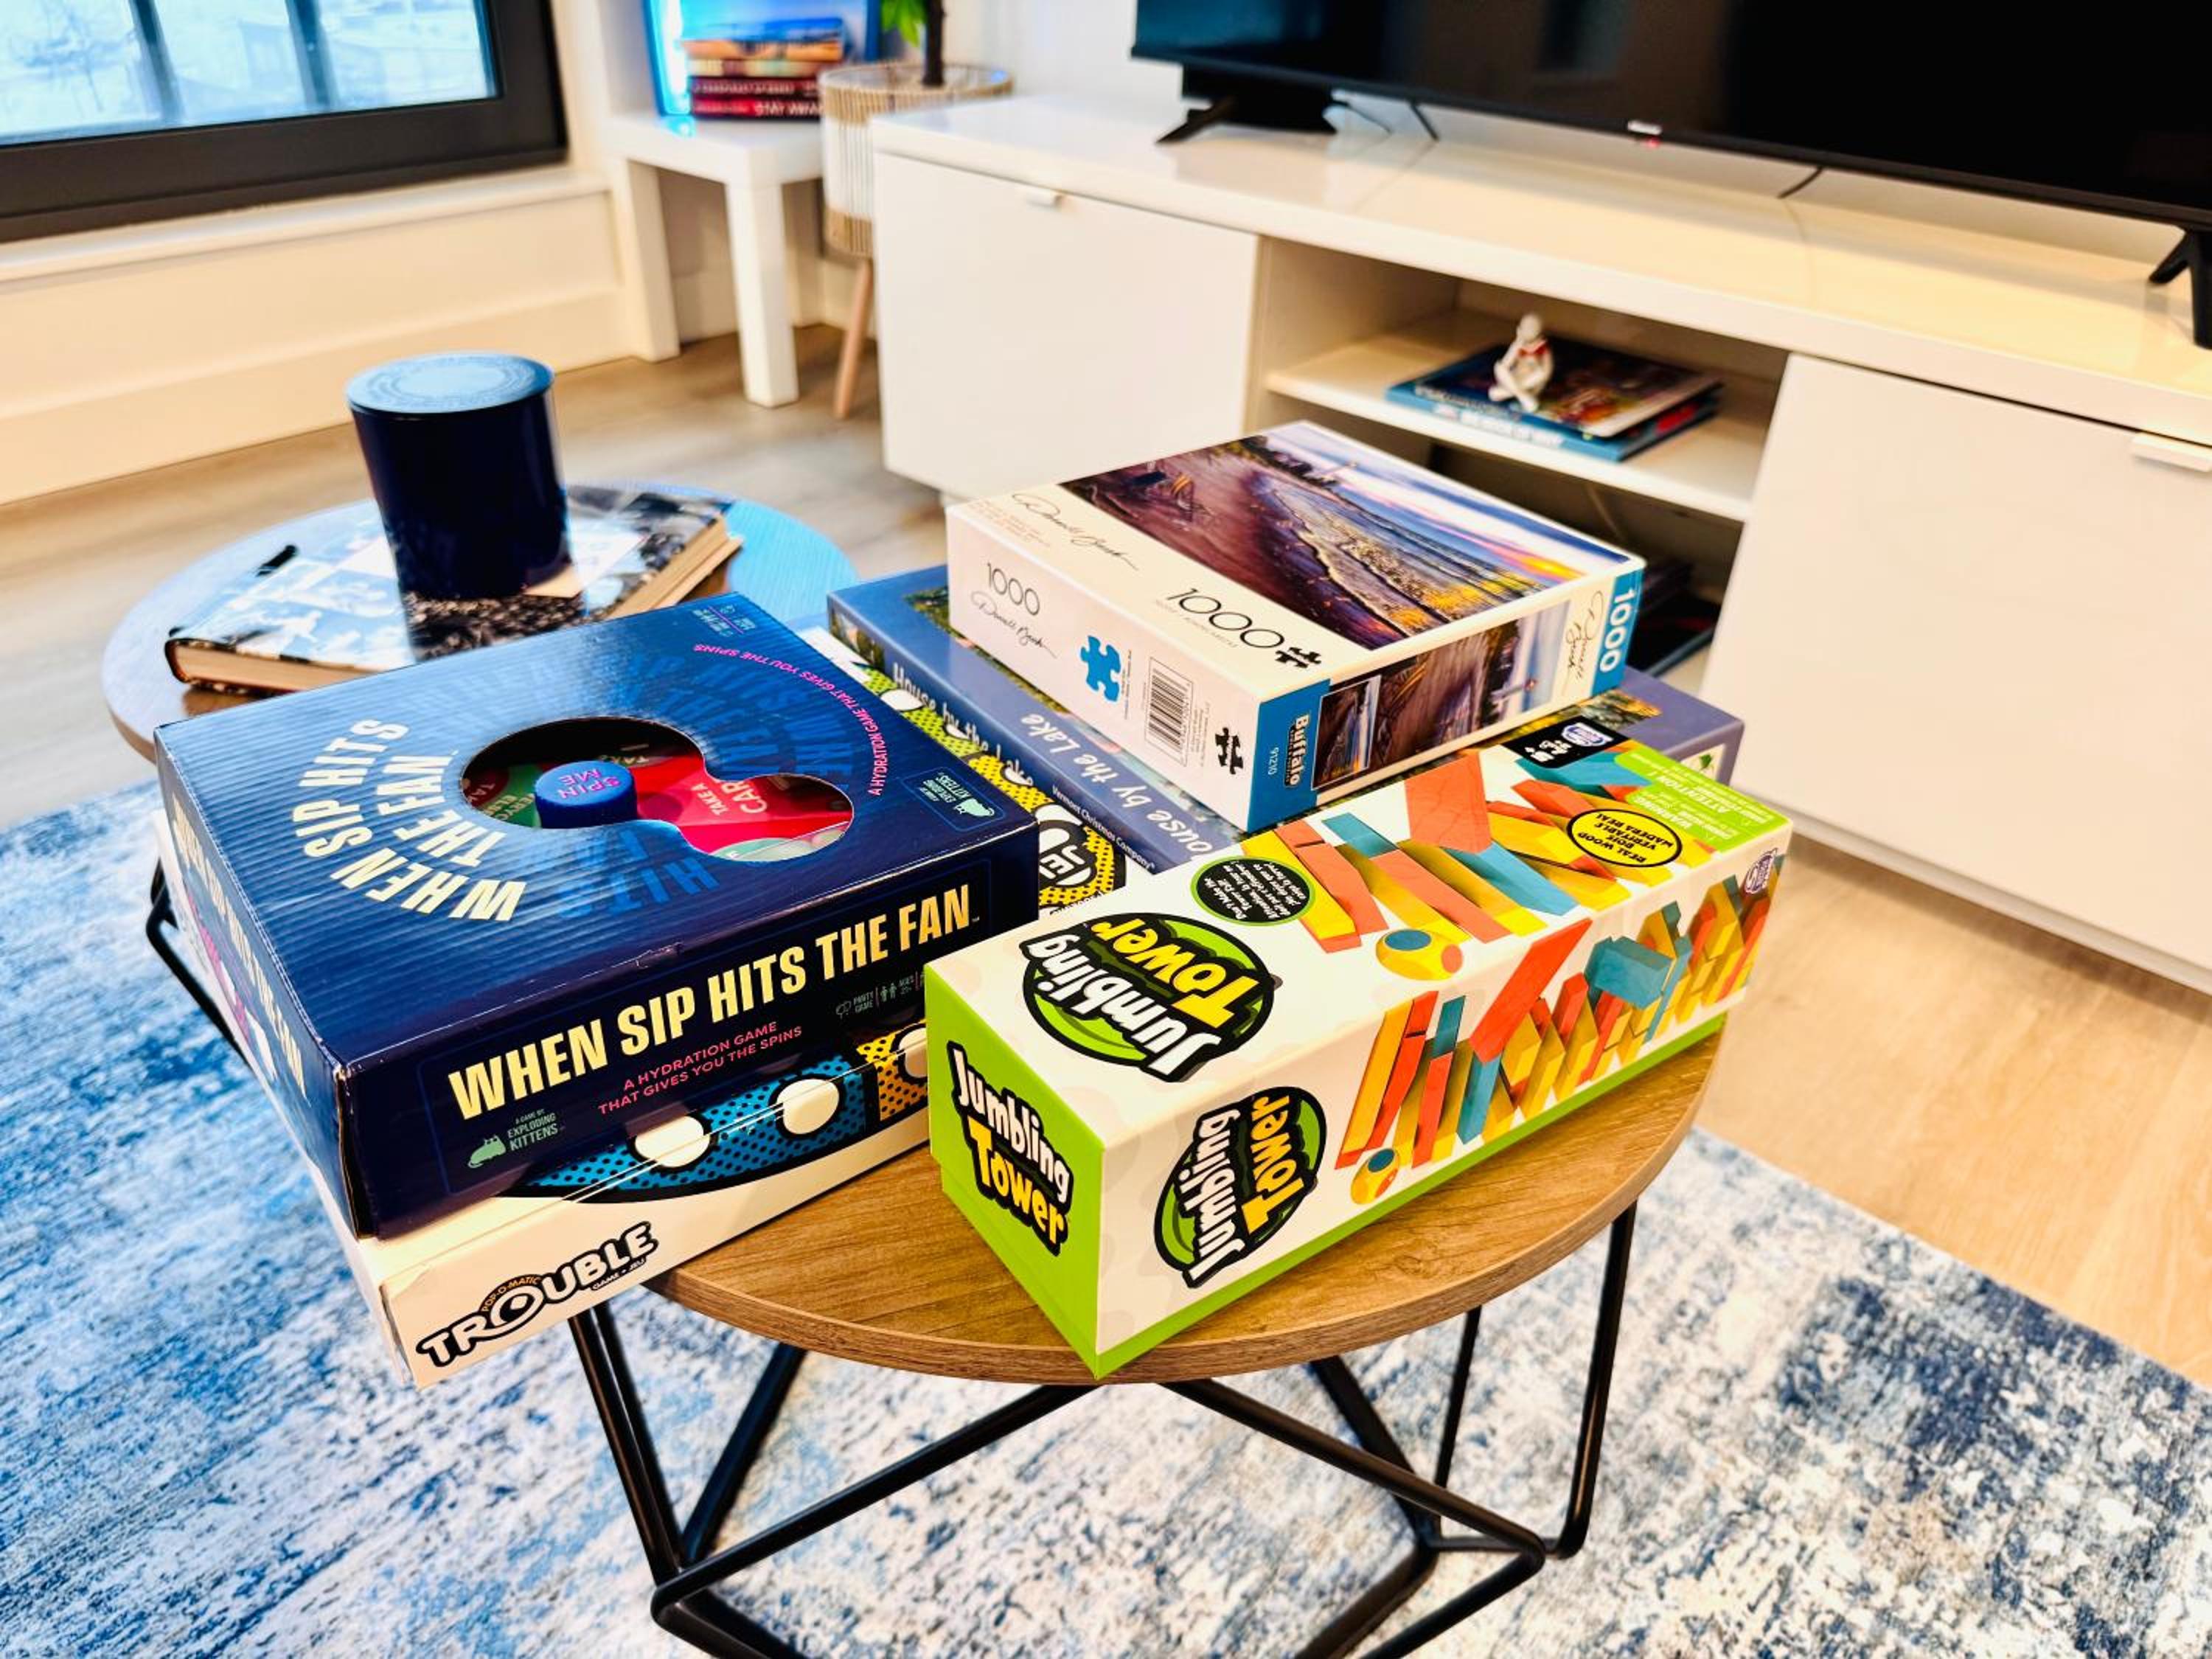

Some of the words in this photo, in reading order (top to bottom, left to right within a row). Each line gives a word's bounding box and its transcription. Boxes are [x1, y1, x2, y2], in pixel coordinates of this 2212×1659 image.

[987, 562, 1040, 616] 1000
[1167, 588, 1285, 648] 1000
[1600, 588, 1637, 672] 1000
[693, 644, 740, 657] SPINS
[740, 652, 769, 664] THE
[768, 660, 799, 674] YOU
[799, 671, 835, 691] GIVES
[829, 689, 859, 709] THAT
[852, 708, 879, 732] GAME
[1020, 712, 1081, 754] Lake
[299, 720, 409, 787] HITS
[869, 733, 888, 787] HYDRATION
[1074, 753, 1118, 784] the
[1290, 713, 1310, 786] Buffalo
[377, 755, 453, 815] FAN
[557, 776, 621, 799] SPIN
[558, 768, 602, 785] ME
[691, 783, 709, 791] A
[721, 781, 767, 813] CAR
[867, 788, 883, 796] A
[1113, 785, 1152, 808] by
[697, 790, 728, 815] TAKE
[1051, 784, 1082, 813] Vermont
[1081, 808, 1116, 841] Christmas
[291, 800, 374, 858] SIP
[392, 809, 507, 867] THE
[1147, 810, 1213, 854] ouse
[1576, 830, 1614, 849] WOOD
[1616, 847, 1646, 863] REAL
[330, 847, 527, 922] WHEN
[1091, 918, 1260, 1029] Tower
[448, 1020, 606, 1120] WHEN
[616, 979, 696, 1057] SIP
[707, 946, 807, 1023] HITS
[815, 924, 888, 979] THE
[898, 884, 970, 952] FAN
[1028, 933, 1222, 1077] Jumbling
[598, 1096, 641, 1116] THAT
[644, 1075, 689, 1102] GIVES
[691, 1061, 723, 1084] YOU
[728, 1047, 757, 1068] THE
[760, 1026, 803, 1055] SPINS
[622, 1077, 635, 1092] A
[637, 1041, 731, 1087] HYDRATION
[734, 1021, 777, 1049] GAME
[507, 1113, 557, 1138] EXPLODING
[509, 1123, 558, 1151] KITTENS
[953, 1048, 1071, 1203] Jumbling
[967, 1115, 1068, 1246] Tower
[1241, 1095, 1305, 1234] Tower
[1178, 1108, 1248, 1281] Jumbling
[417, 1222, 658, 1366] TROUBLE
[481, 1276, 542, 1312] POP-O-MATIC
[591, 1272, 621, 1291] GAME
